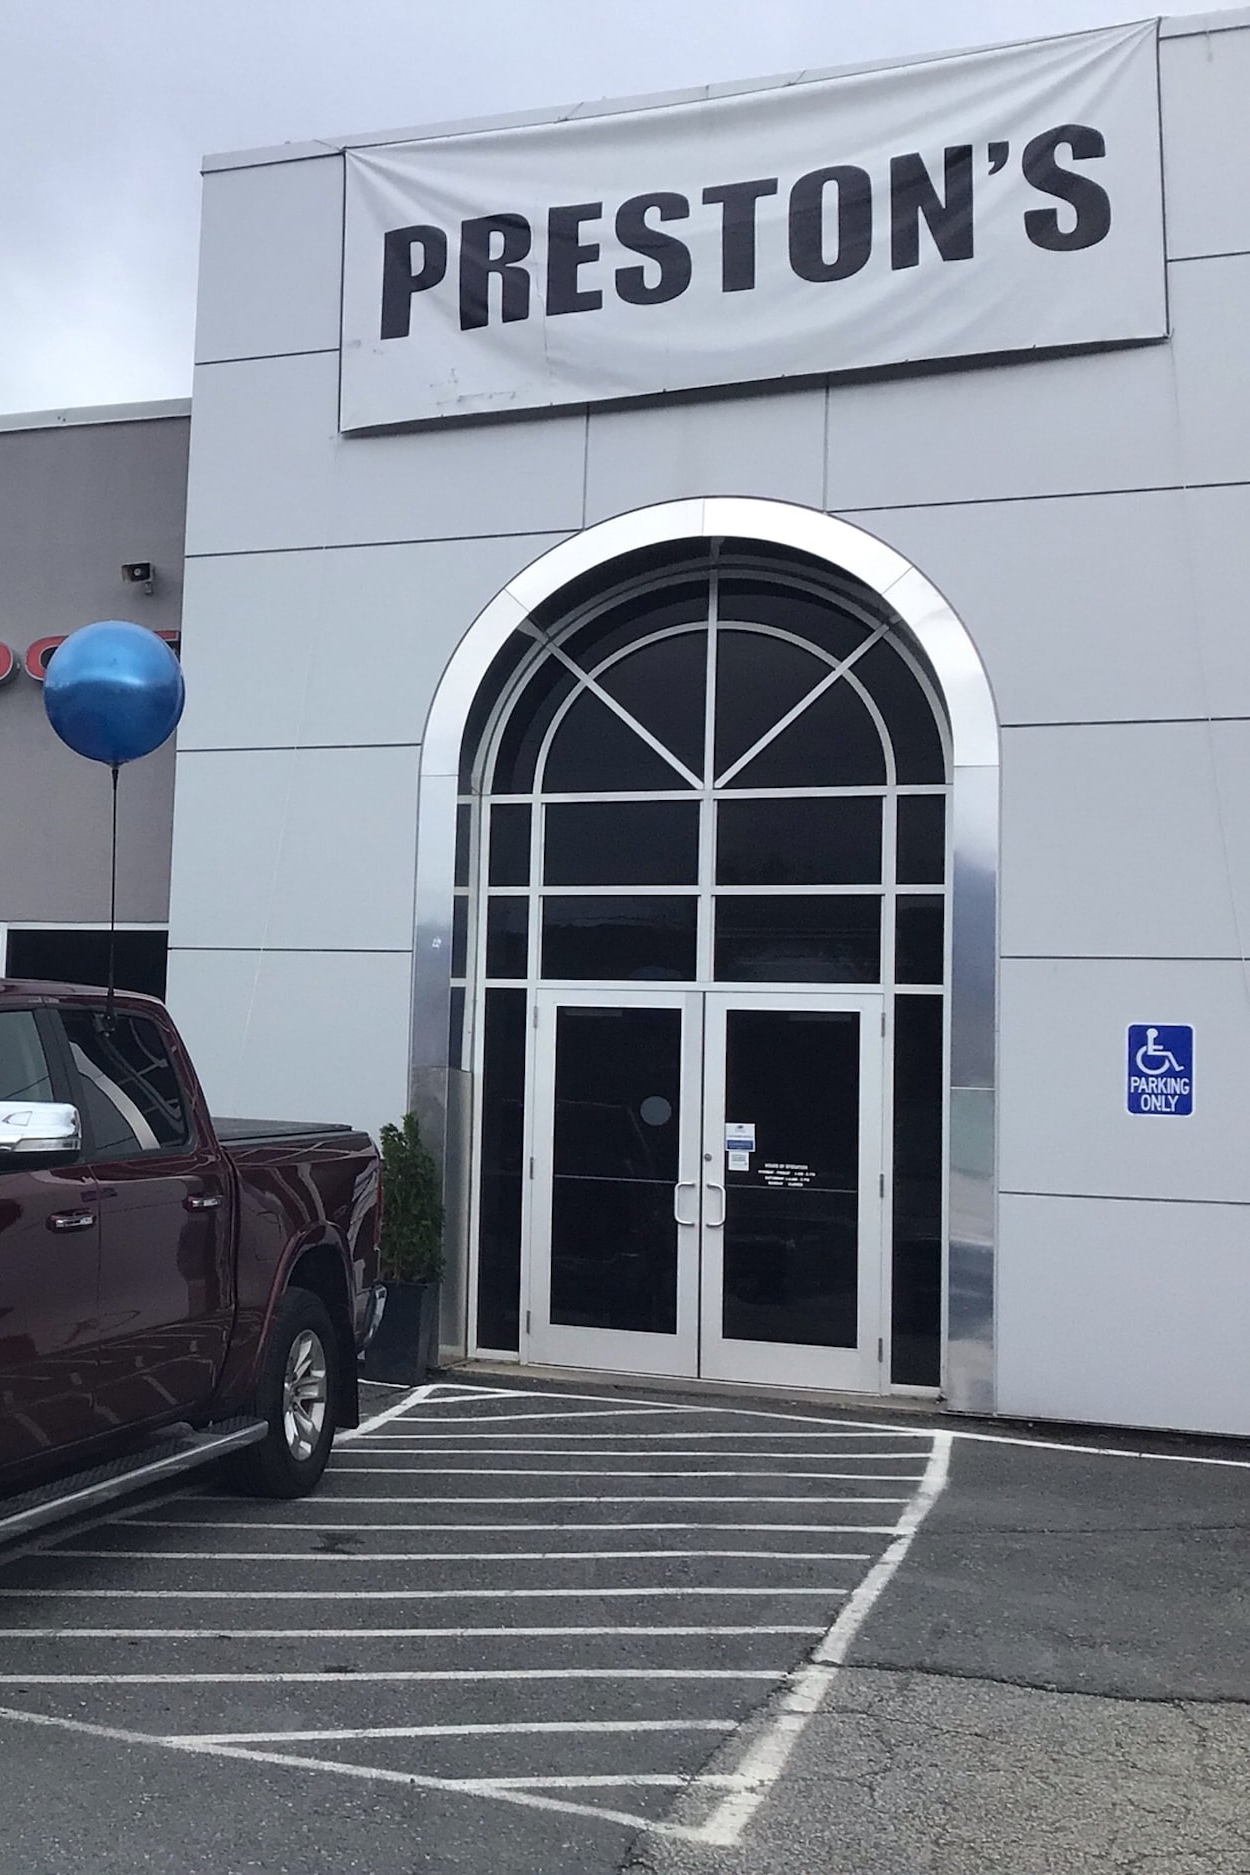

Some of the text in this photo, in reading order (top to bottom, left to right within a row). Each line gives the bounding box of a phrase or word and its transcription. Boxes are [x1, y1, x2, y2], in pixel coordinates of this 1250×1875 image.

[380, 124, 1111, 340] PRESTON'S
[1130, 1076, 1190, 1095] PARKING
[1140, 1094, 1179, 1112] ONLY
